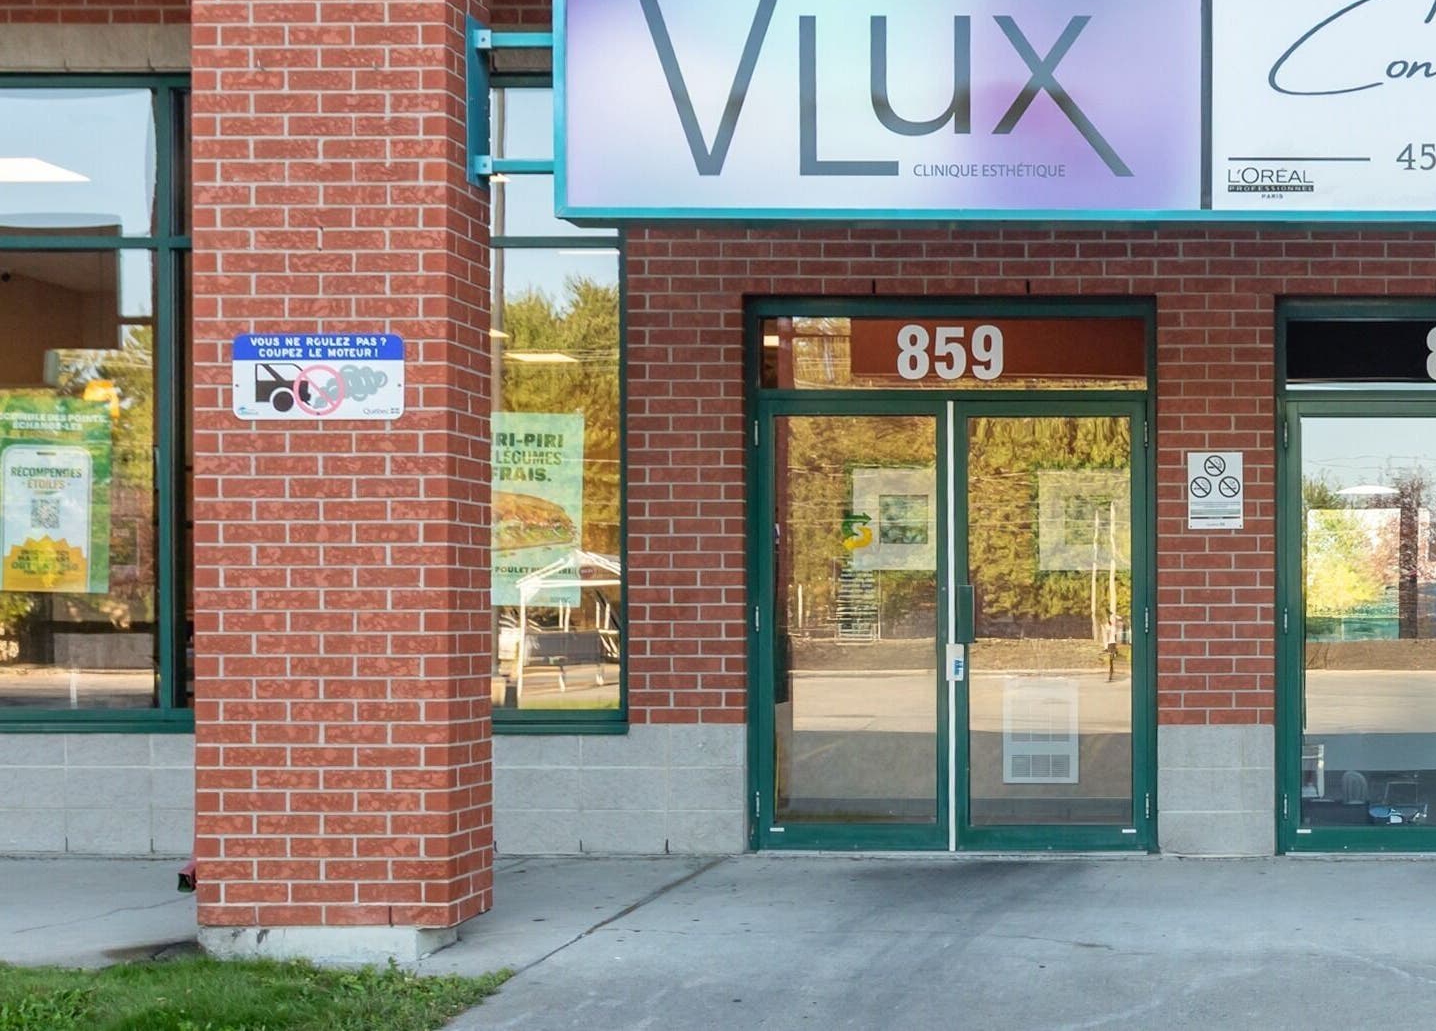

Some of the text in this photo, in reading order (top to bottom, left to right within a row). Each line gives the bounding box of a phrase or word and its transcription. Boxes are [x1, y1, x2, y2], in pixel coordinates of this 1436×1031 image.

[913, 162, 1065, 177] CLINIQUE ESTHÉTIQUE
[250, 337, 279, 346] VOUS
[285, 337, 300, 346] NE
[306, 337, 350, 346] ROULEZ
[356, 337, 377, 346] PAS
[259, 348, 303, 357] COUPEZ
[309, 348, 322, 357] LE
[327, 348, 372, 357] MOTEUR
[896, 324, 1004, 380] 859
